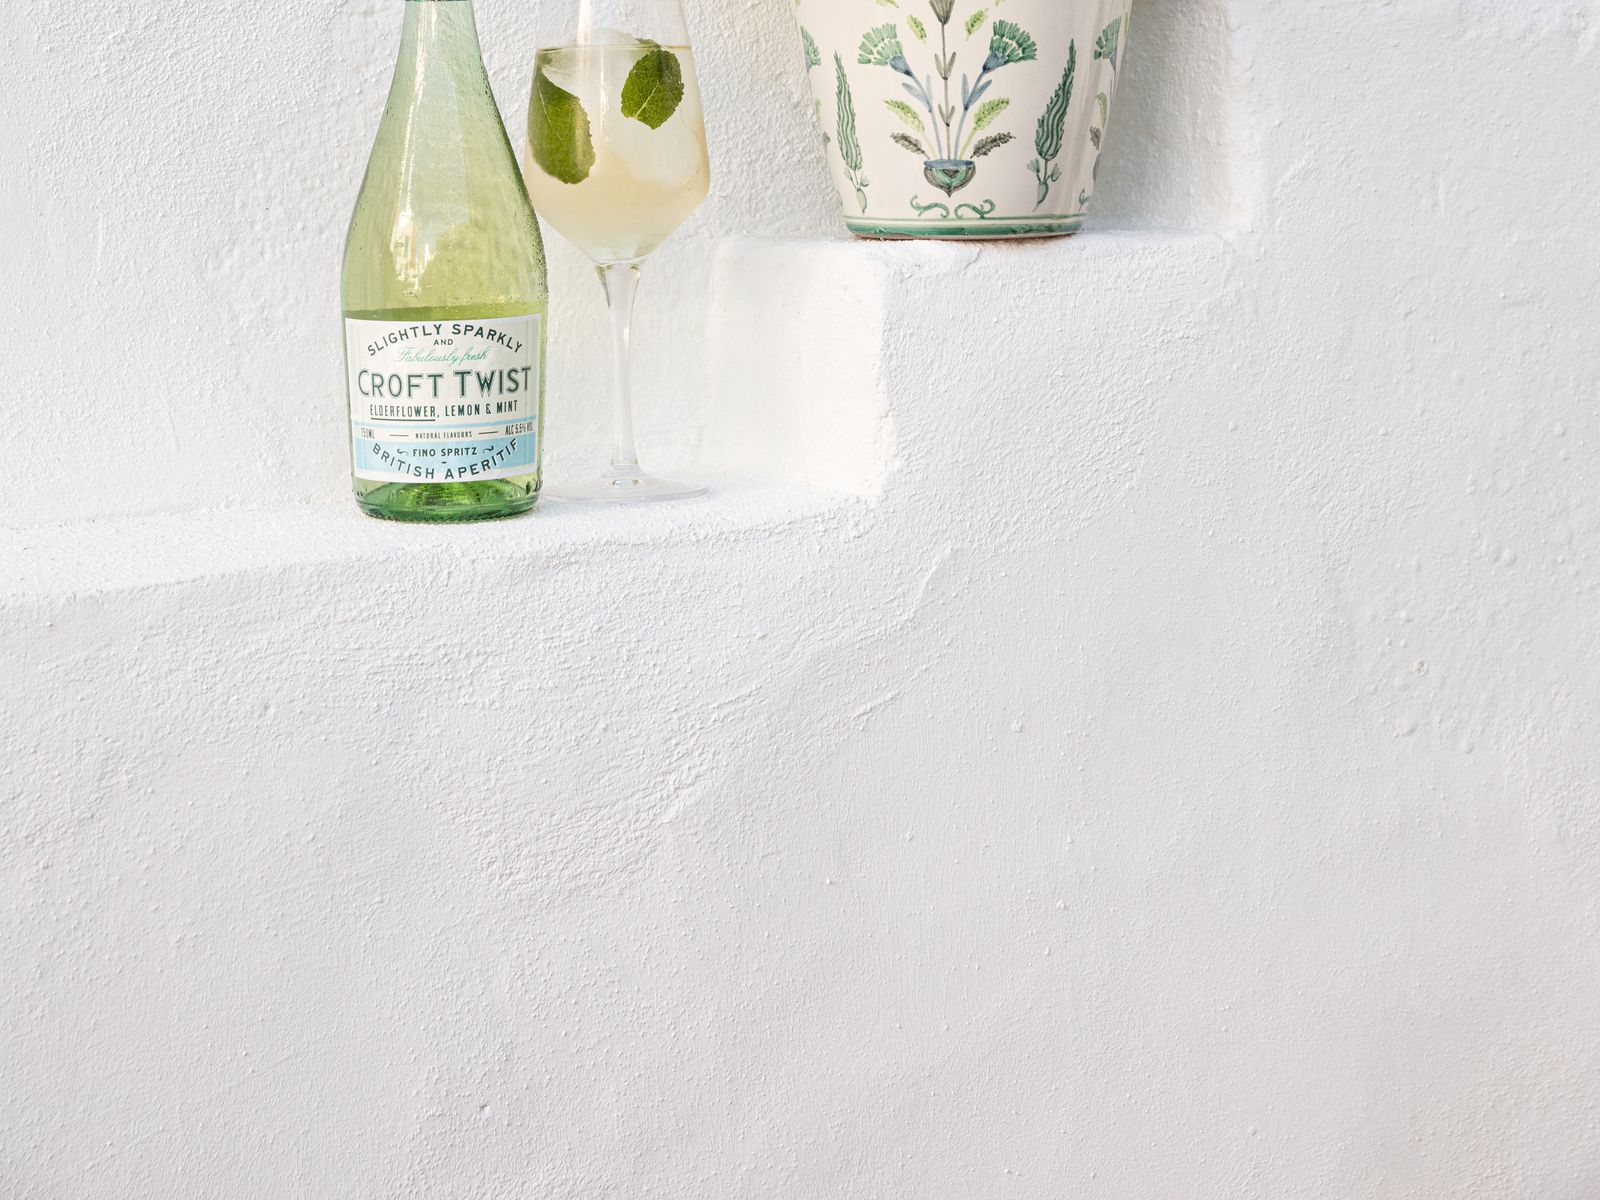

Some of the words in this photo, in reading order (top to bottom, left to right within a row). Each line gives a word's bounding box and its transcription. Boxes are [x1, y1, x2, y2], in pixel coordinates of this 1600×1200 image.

[367, 323, 442, 356] SLIGHTLY
[451, 323, 523, 353] SPARKLY
[433, 338, 454, 346] AND
[394, 347, 459, 367] Fabulously
[458, 345, 491, 367] fresh
[358, 367, 445, 399] CROFT
[453, 365, 532, 399] TWIST
[369, 403, 440, 419] ELDERFLOWER,
[445, 404, 480, 417] LEMON
[485, 403, 492, 415] &
[496, 400, 518, 414] MINT
[443, 430, 473, 439] FLAVOURS
[505, 424, 515, 435] ALC
[372, 443, 435, 480] BRITISH
[444, 438, 518, 480] APERITIF
[412, 448, 436, 457] FINO
[440, 446, 478, 457] SPRITZ
